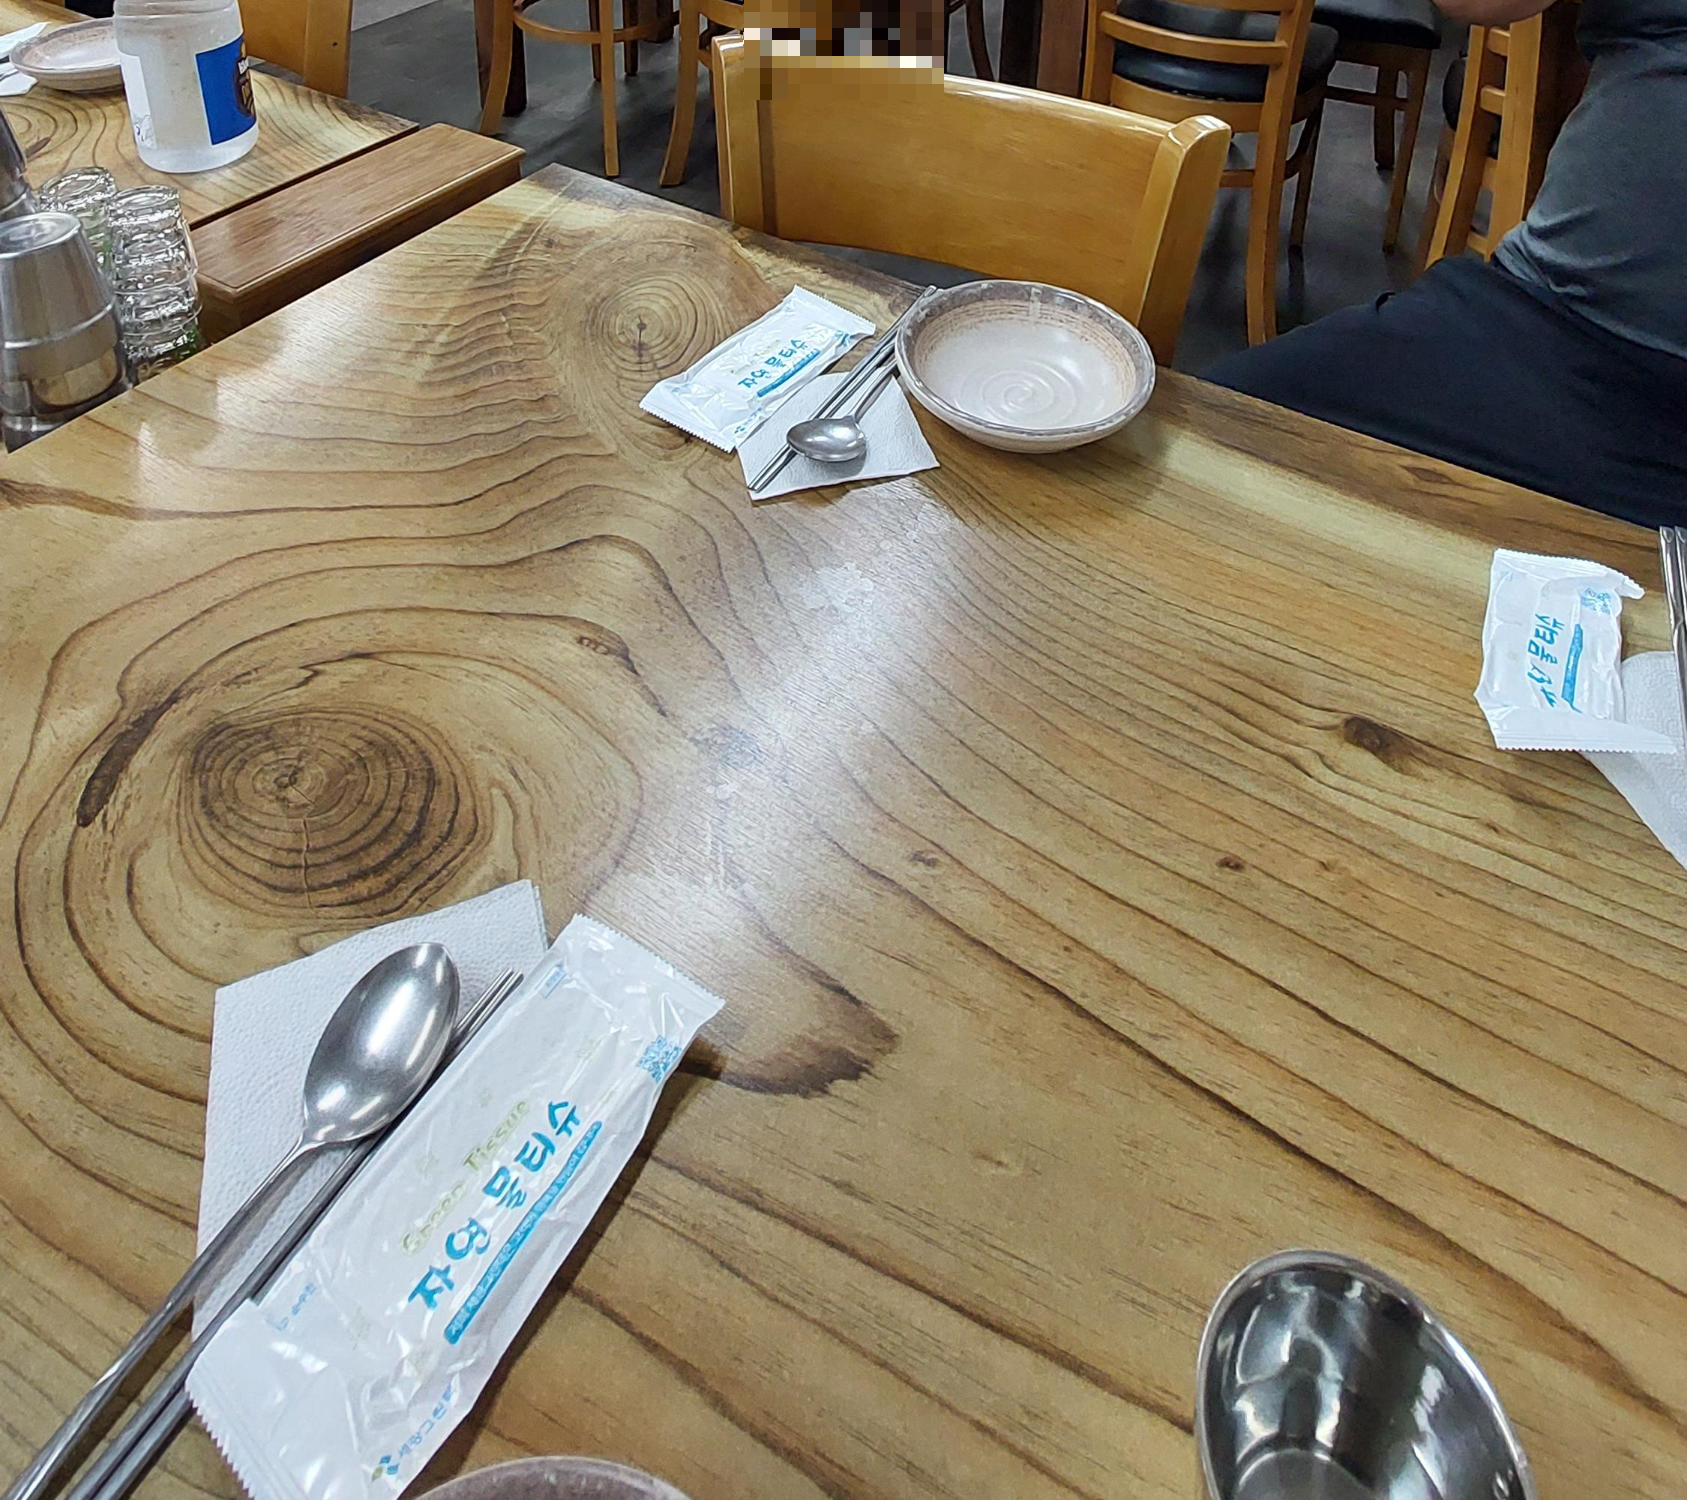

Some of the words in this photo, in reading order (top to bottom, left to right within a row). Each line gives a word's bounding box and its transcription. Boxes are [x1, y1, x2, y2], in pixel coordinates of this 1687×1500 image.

[737, 368, 772, 389] 자연
[764, 338, 807, 369] 물티슈
[1527, 612, 1565, 666] 물티슈
[463, 1100, 531, 1173] Tissue
[408, 1217, 492, 1311] 자연
[482, 1100, 584, 1212] 물티슈
